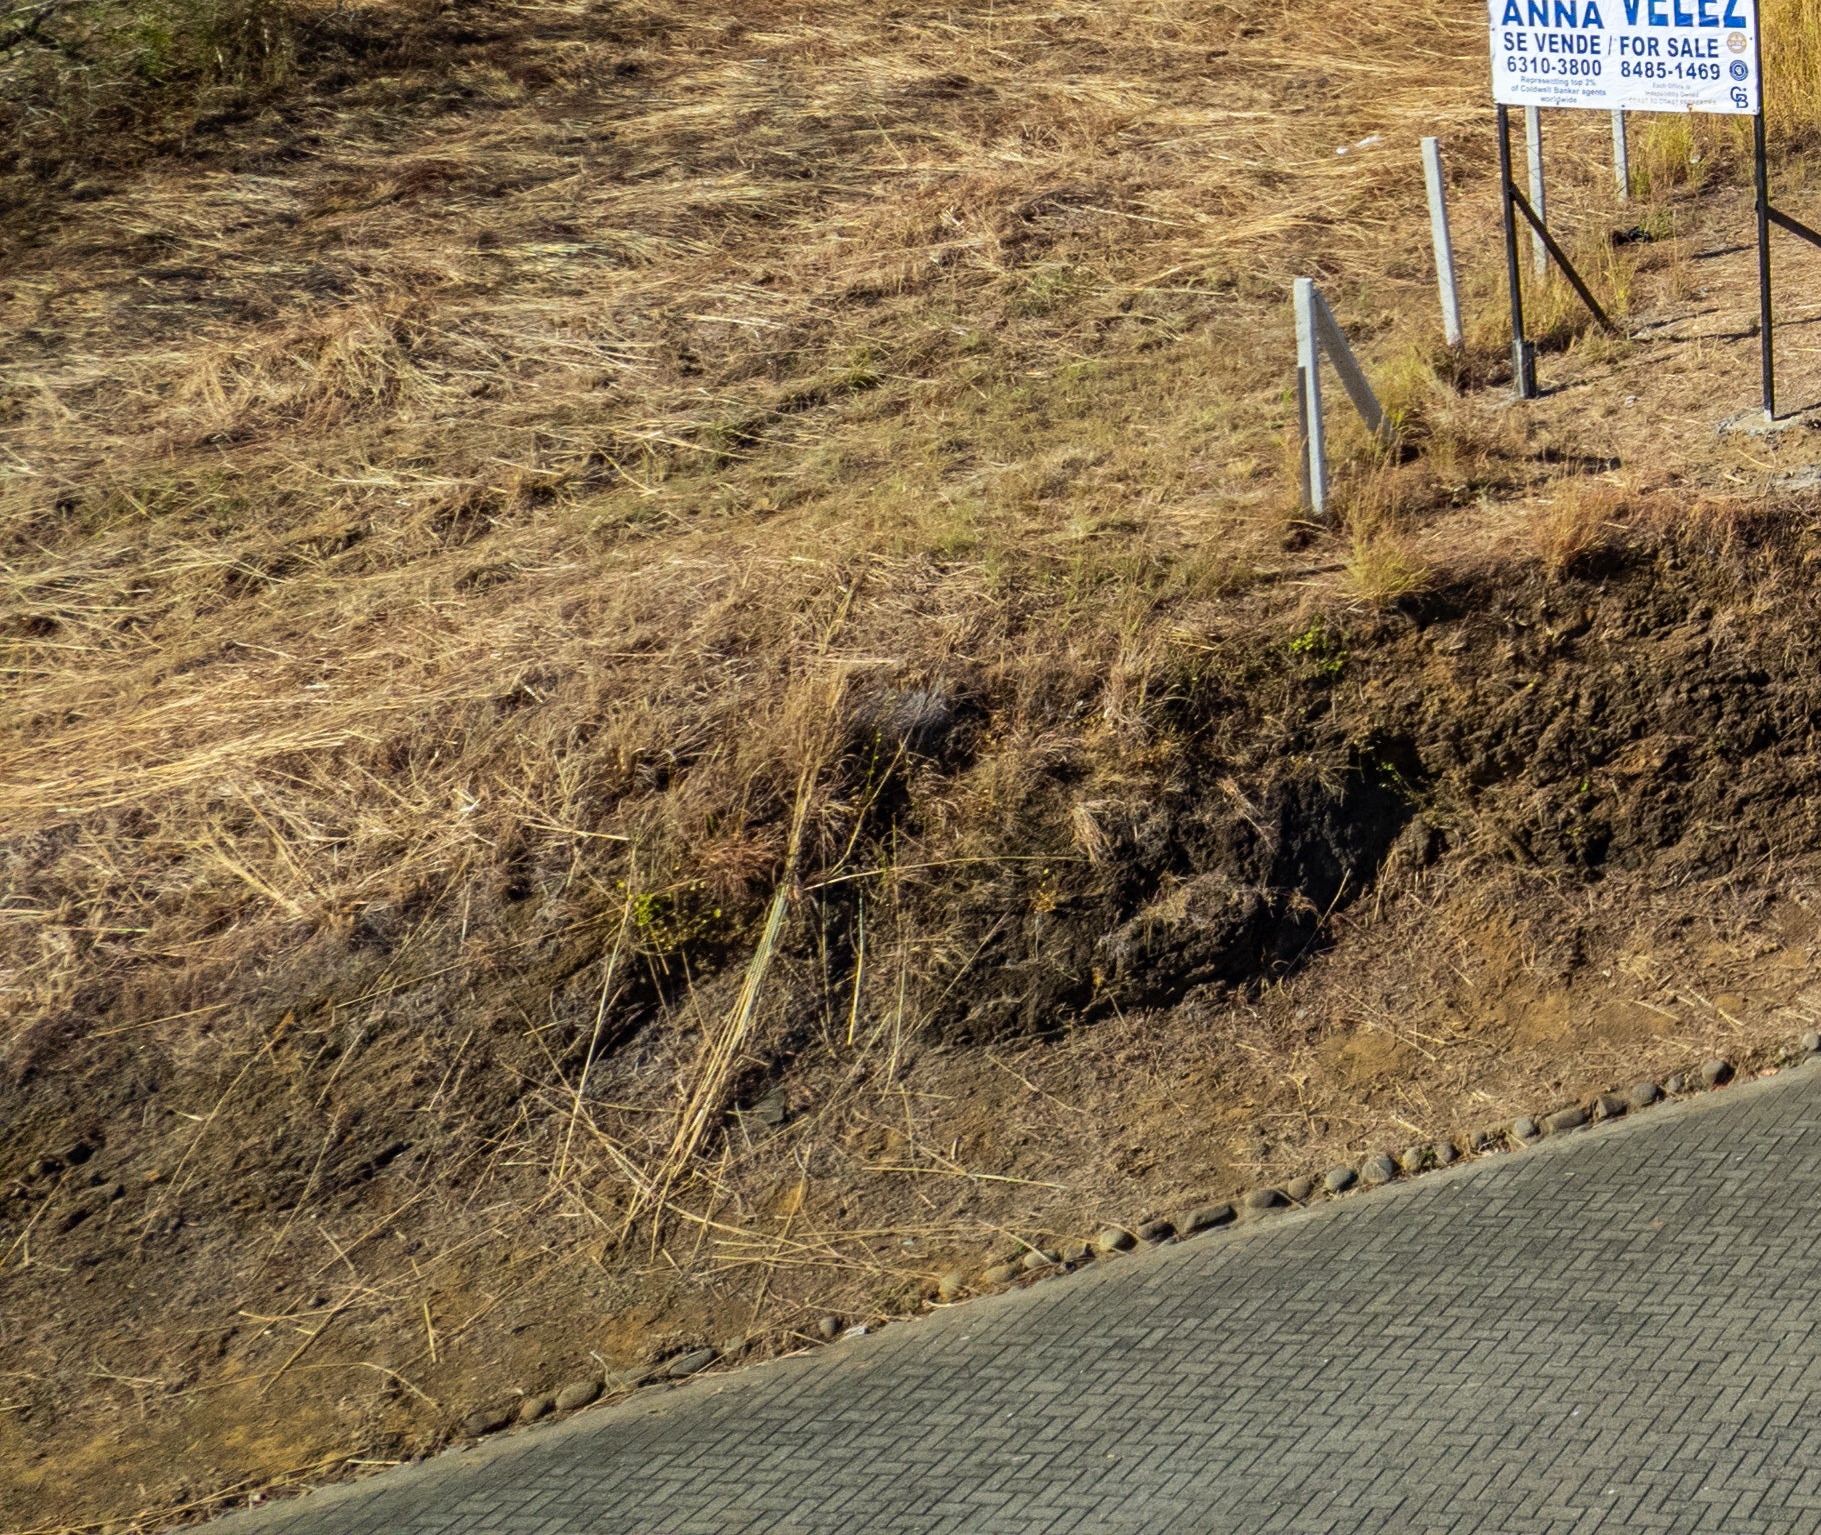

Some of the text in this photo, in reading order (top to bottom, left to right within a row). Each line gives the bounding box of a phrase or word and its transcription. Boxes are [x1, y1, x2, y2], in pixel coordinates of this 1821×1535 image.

[1502, 0, 1605, 29] ANNA
[1504, 32, 1528, 51] SE
[1534, 33, 1601, 55] VENDE
[1620, 36, 1660, 57] FOR
[1667, 38, 1719, 58] SALE
[1507, 56, 1602, 76] 6310-3800
[1621, 61, 1720, 80] 8485-1469
